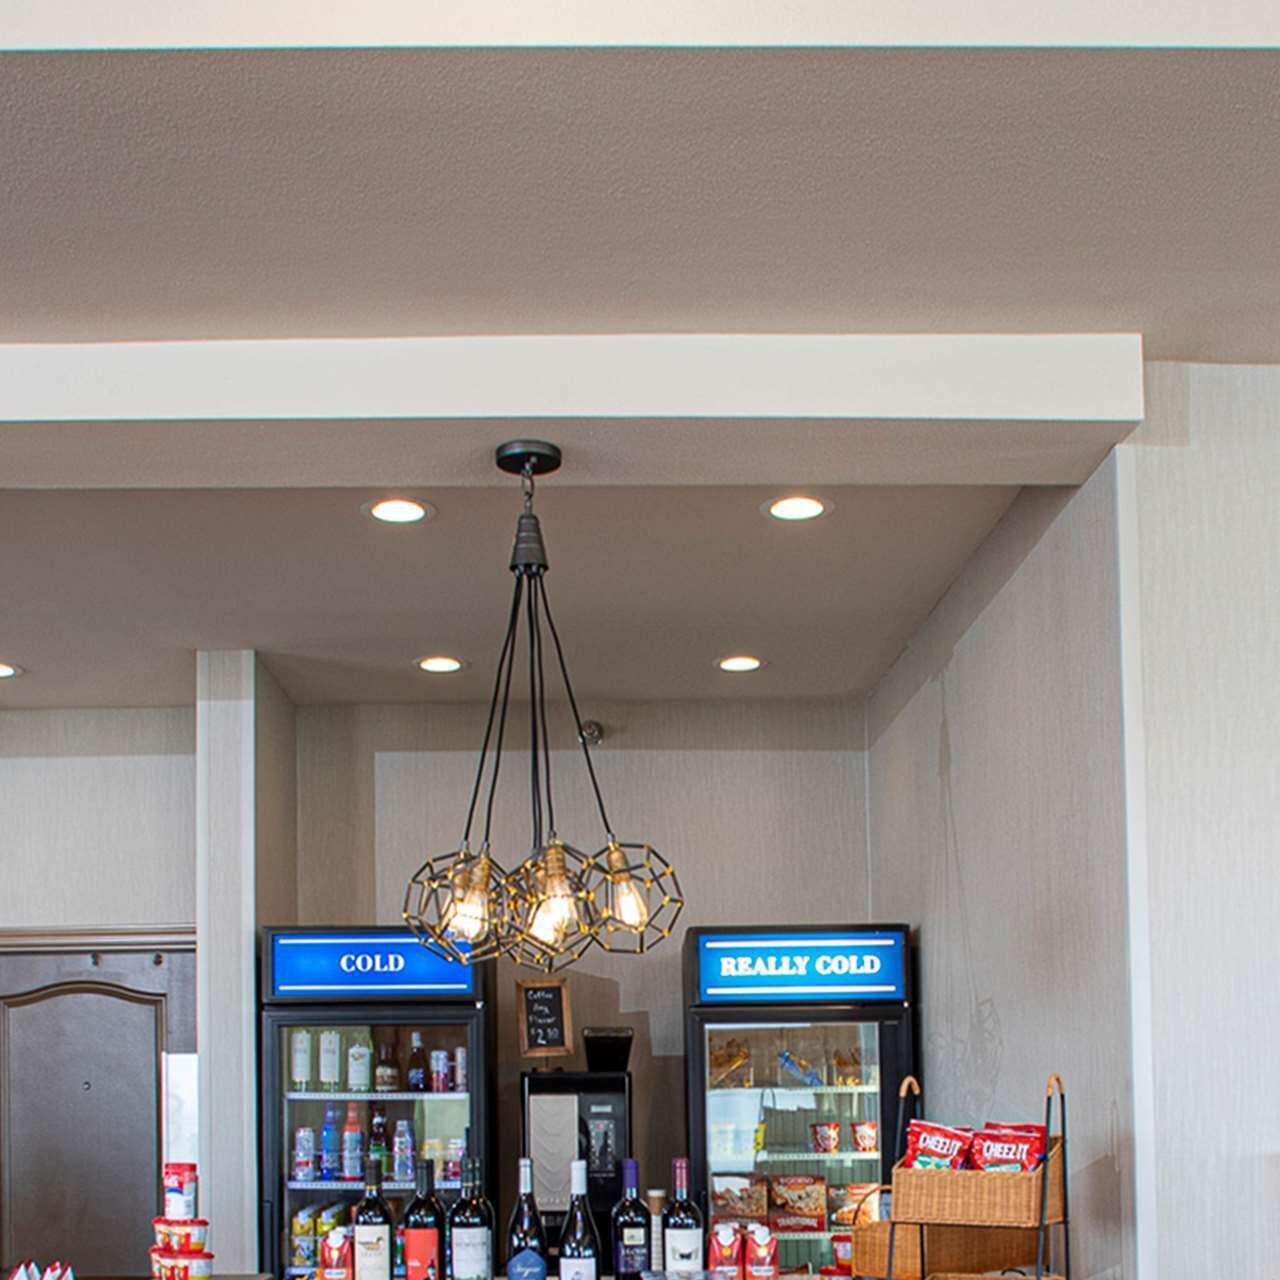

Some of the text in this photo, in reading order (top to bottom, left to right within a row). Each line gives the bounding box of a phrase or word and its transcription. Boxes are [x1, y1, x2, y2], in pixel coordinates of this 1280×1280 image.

[339, 953, 405, 973] COLD
[719, 953, 881, 977] REALLY COLD
